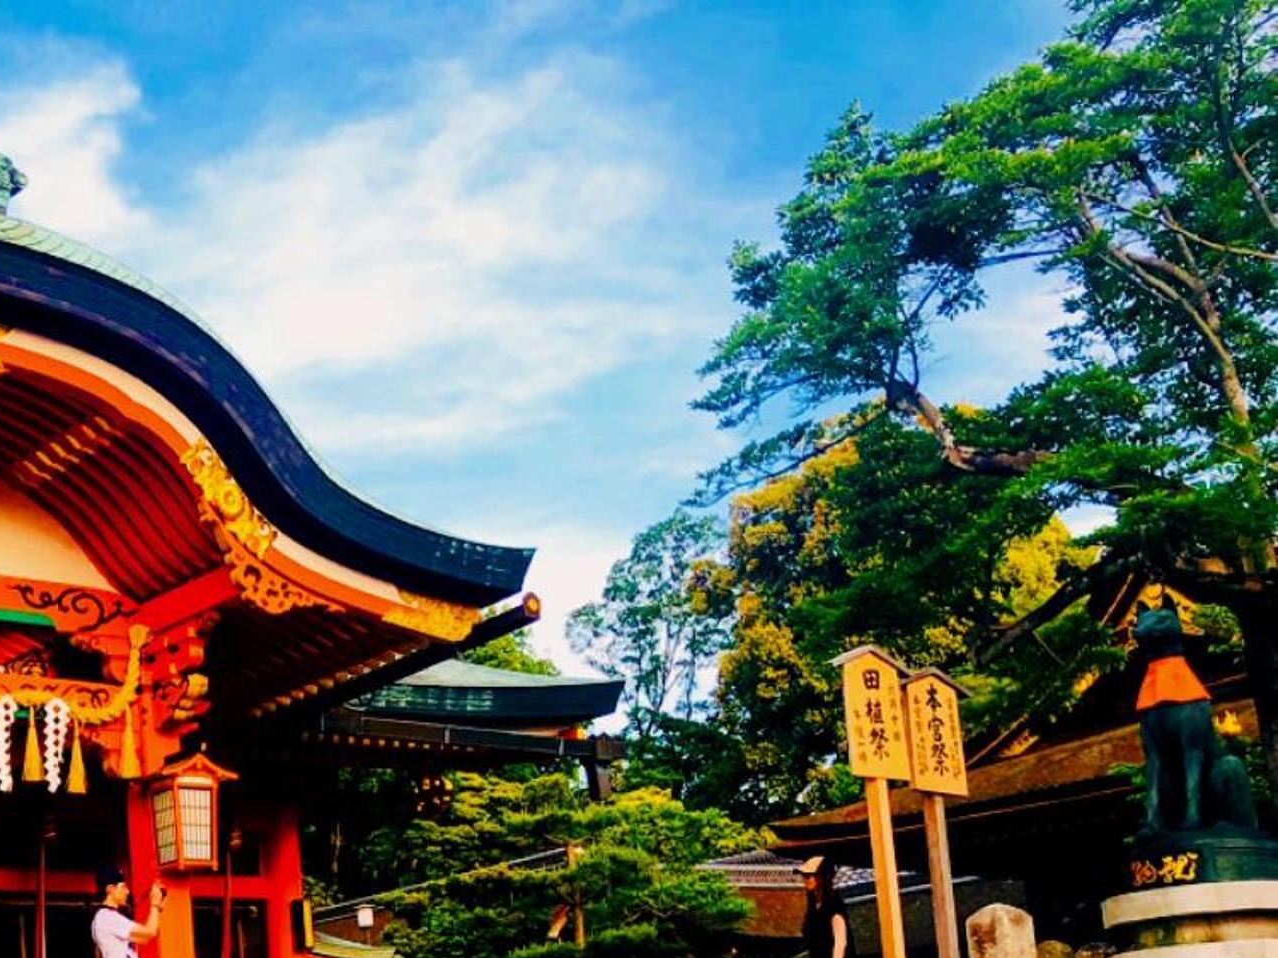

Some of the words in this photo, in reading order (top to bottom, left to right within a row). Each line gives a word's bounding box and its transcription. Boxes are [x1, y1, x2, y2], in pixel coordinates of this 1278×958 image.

[862, 669, 890, 761] 田植祭
[926, 683, 950, 777] 本宮祭
